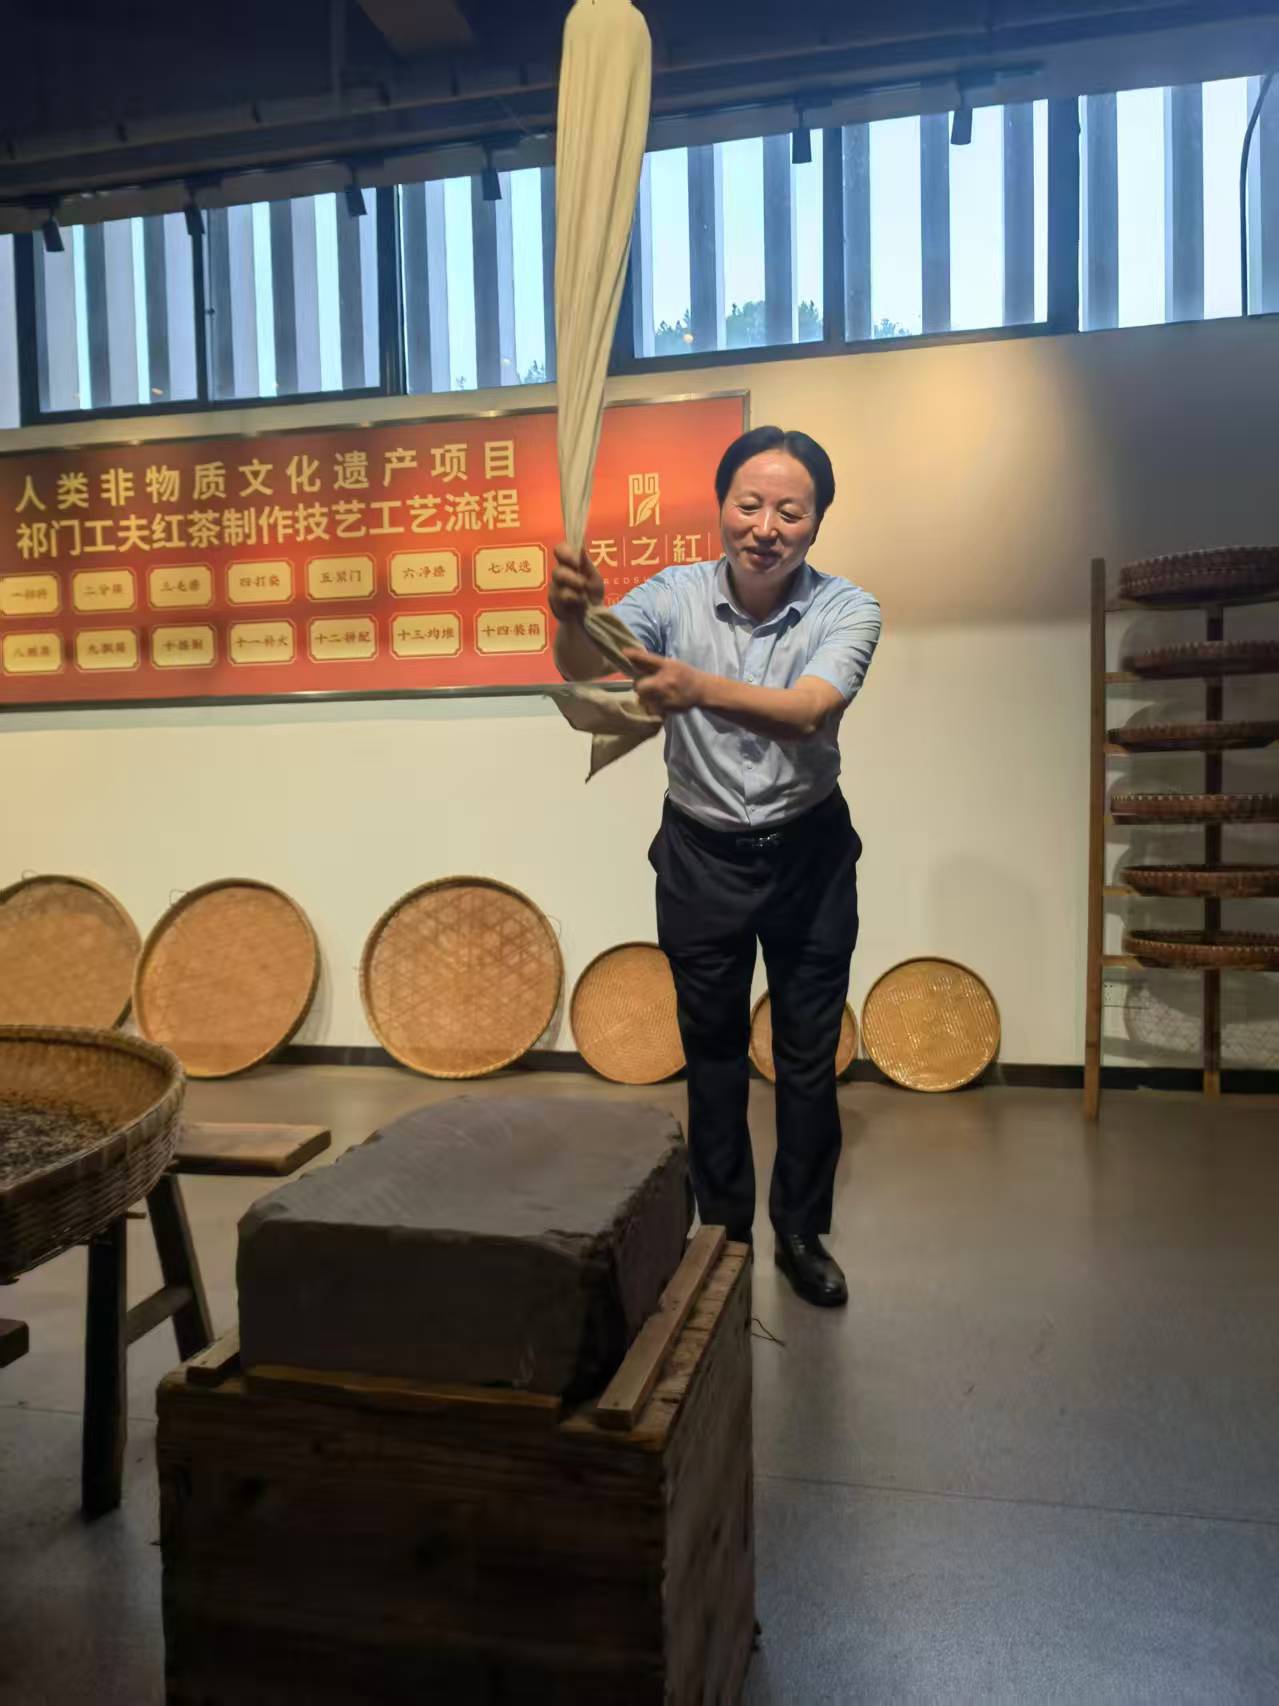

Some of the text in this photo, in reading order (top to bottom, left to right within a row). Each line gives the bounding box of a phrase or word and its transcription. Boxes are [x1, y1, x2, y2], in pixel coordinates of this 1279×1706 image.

[15, 440, 516, 513] 人类非物质文化遗产项目
[16, 489, 521, 559] 祁门工夫红茶制作技艺工艺流程
